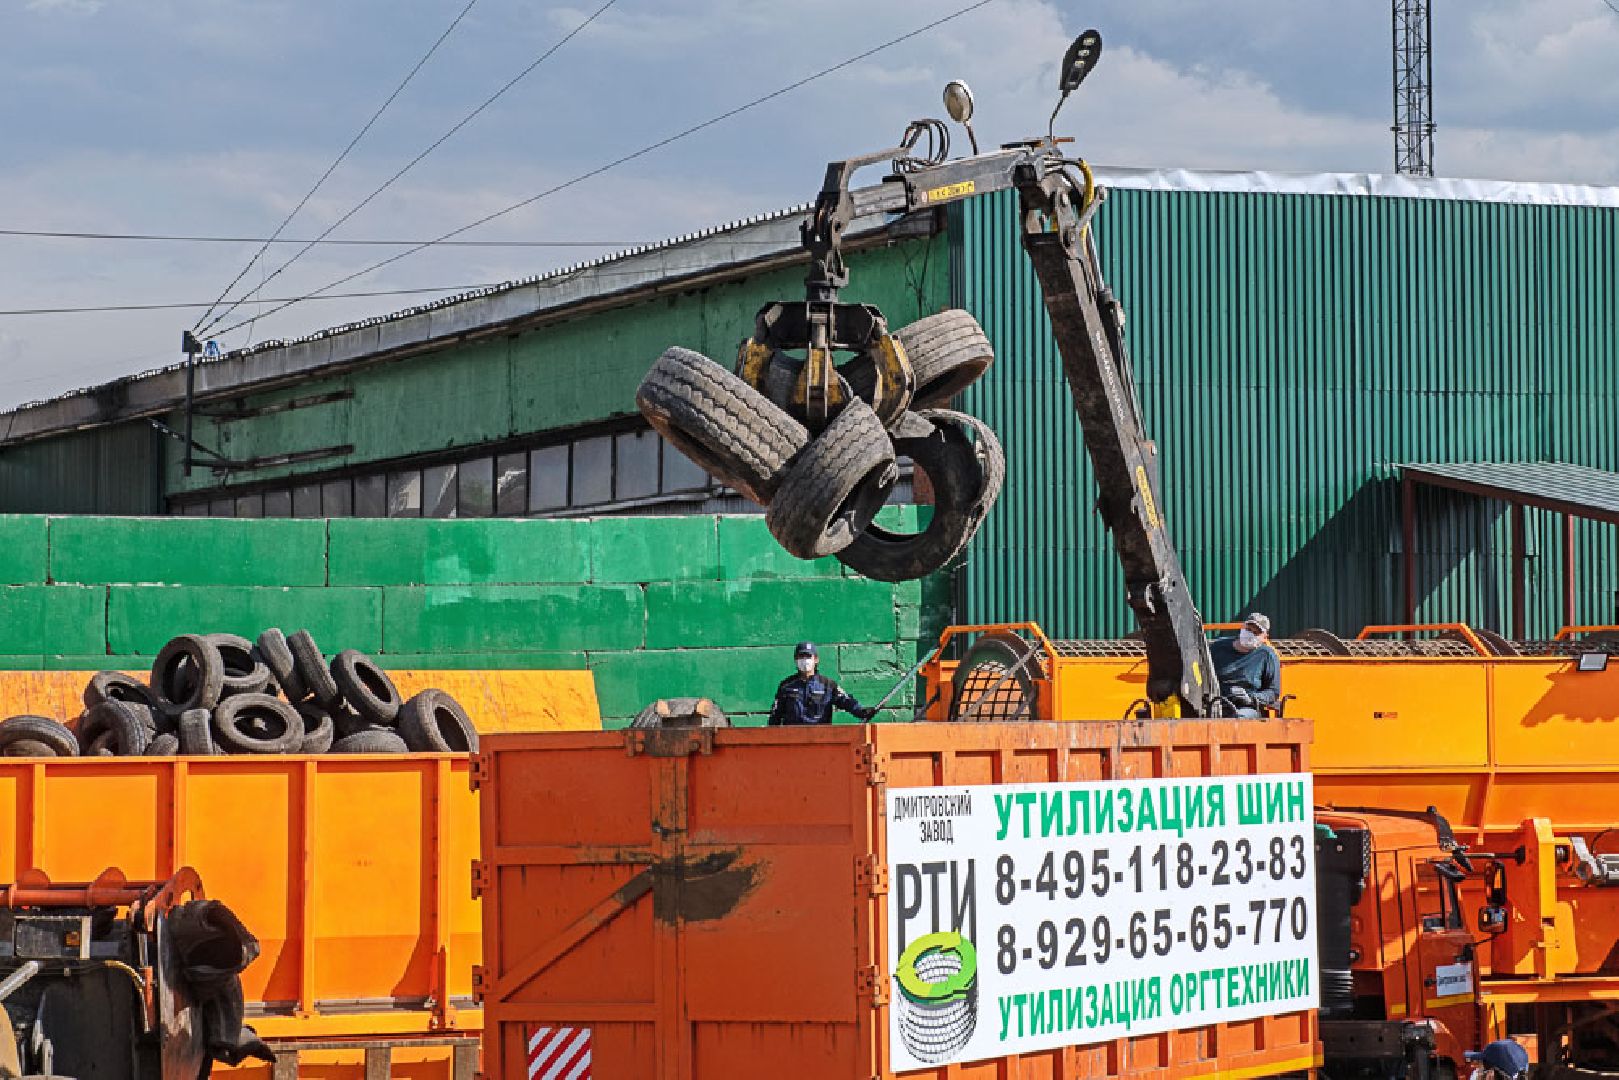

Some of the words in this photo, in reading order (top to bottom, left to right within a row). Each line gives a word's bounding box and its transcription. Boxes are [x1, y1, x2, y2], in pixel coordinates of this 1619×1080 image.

[894, 790, 972, 821] ДМИТРОВСКИЙ
[919, 819, 954, 844] ЗАВОД
[993, 784, 1226, 841] УТИЛИЗАЦИЯ
[1236, 781, 1306, 826] ШИН
[996, 834, 1306, 906] 8-495-118-23-83
[896, 858, 977, 966] РТИ
[997, 896, 1308, 975] 8-929-65-65-770
[998, 976, 1162, 1042] УТИЛИЗАЦИЯ
[1169, 957, 1310, 1016] ОРГТЕХНИКИ
